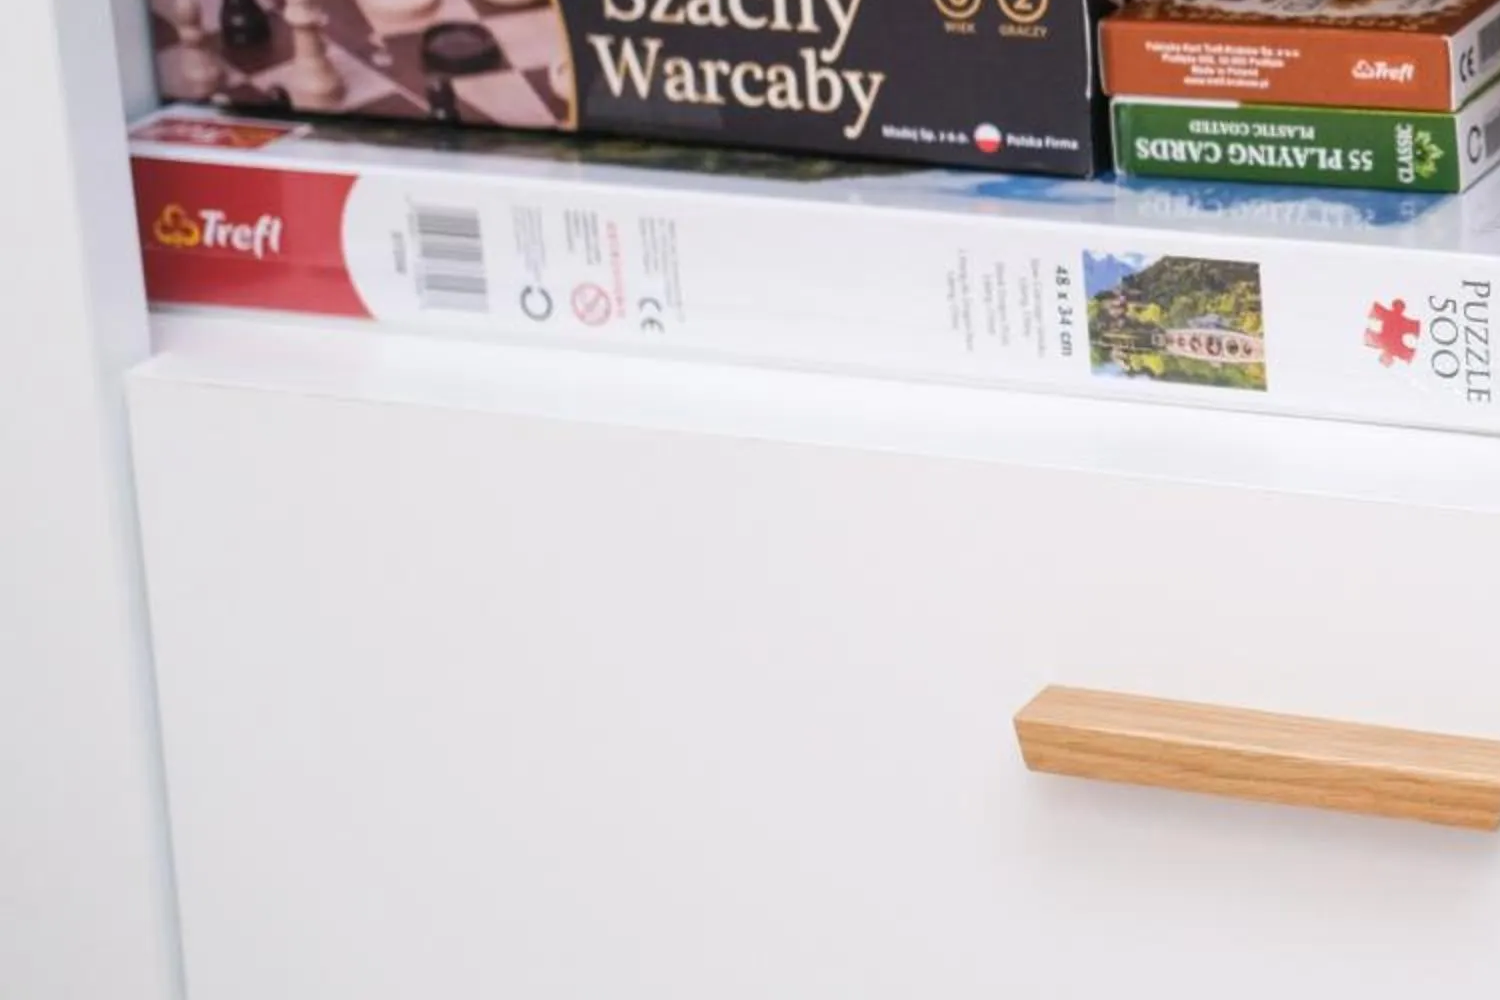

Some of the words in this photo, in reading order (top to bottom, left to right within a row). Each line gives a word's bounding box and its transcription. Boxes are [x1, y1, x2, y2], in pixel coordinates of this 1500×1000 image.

[1374, 61, 1415, 84] Trefl
[586, 32, 886, 139] Warcaby
[1189, 119, 1249, 137] COATED
[1252, 123, 1316, 140] PLASTIC
[1006, 133, 1042, 148] Polska
[1045, 135, 1079, 150] Firma
[1134, 136, 1222, 164] CARDS
[1229, 142, 1343, 170] PLAYING
[1349, 149, 1373, 172] 55
[200, 209, 282, 260] Trefl
[1056, 266, 1071, 286] 48
[1058, 306, 1073, 325] 34
[1429, 296, 1460, 378] 500
[1462, 280, 1491, 403] PUZZLE
